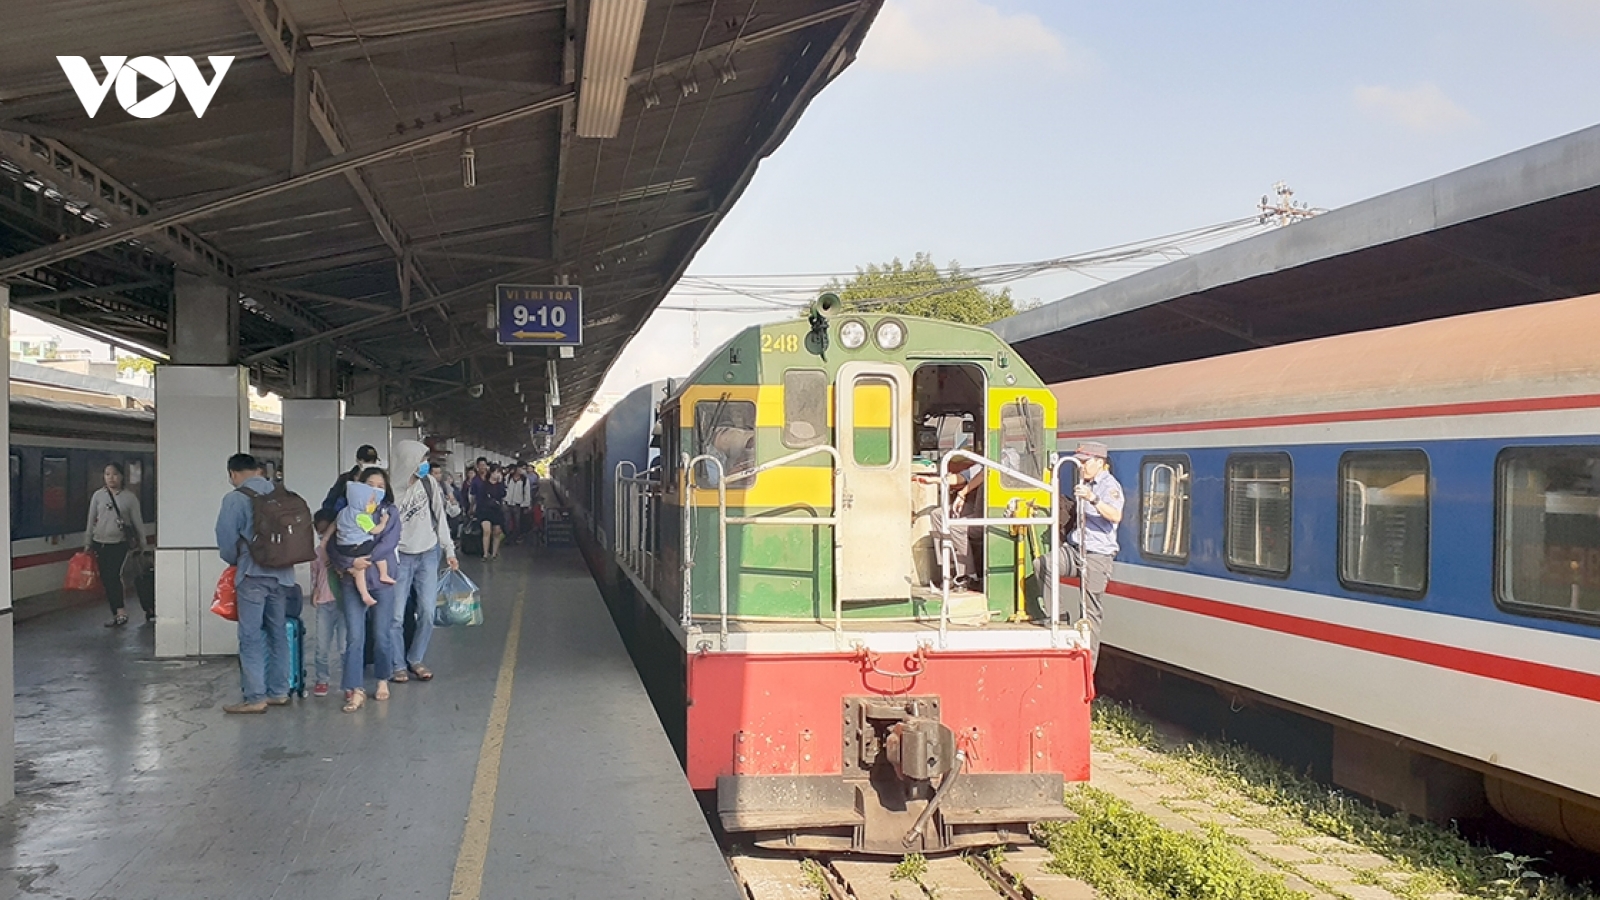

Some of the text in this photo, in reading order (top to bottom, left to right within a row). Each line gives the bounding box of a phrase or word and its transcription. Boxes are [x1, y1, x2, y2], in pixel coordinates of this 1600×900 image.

[548, 290, 573, 301] TOA
[513, 304, 566, 327] 9-10
[761, 334, 798, 353] 248
